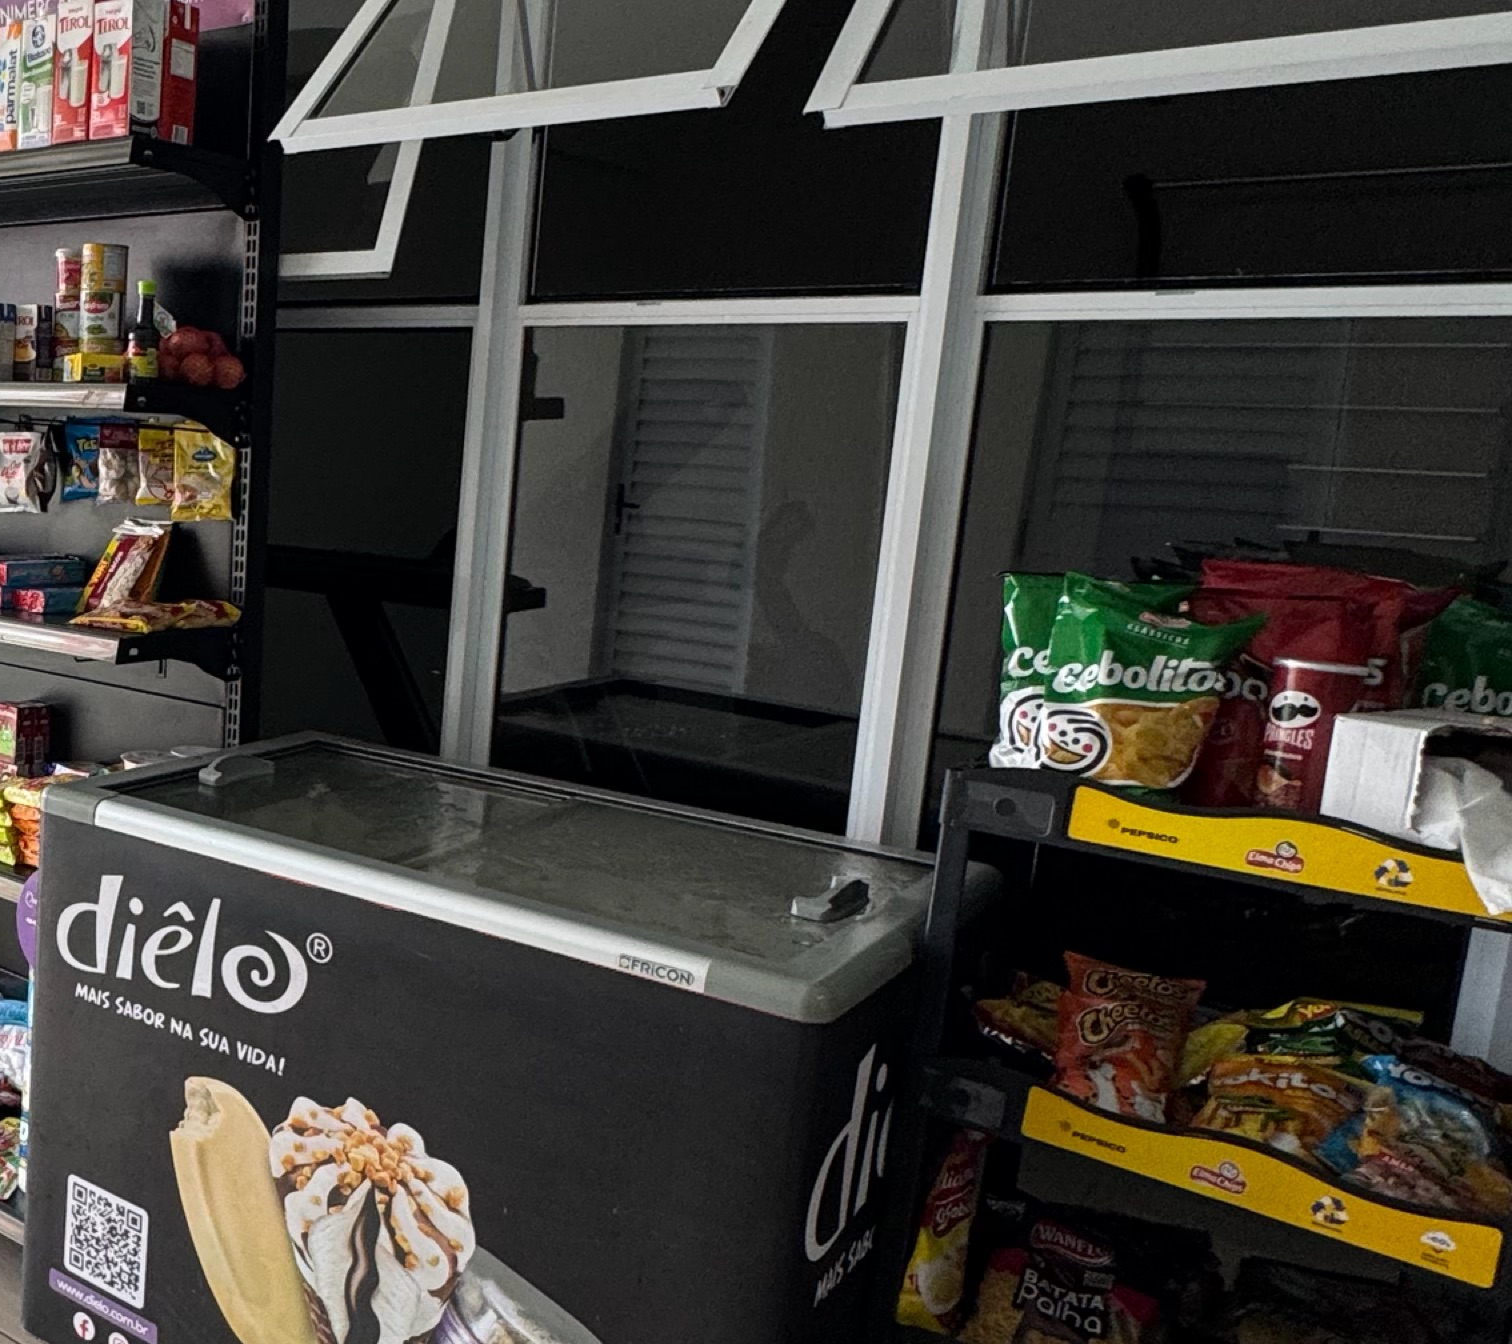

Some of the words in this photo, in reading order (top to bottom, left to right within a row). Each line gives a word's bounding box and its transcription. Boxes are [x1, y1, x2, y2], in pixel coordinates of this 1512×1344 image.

[59, 14, 91, 34] TIROL
[97, 16, 131, 36] TIROL
[5, 48, 18, 125] parmalat
[1264, 723, 1315, 751] PRINGLES
[1120, 826, 1180, 844] PEPSICO
[56, 874, 308, 1014] diêlo
[631, 958, 691, 986] FRICON
[75, 982, 110, 1008] MAIS
[115, 996, 165, 1029] SABOR
[170, 1017, 193, 1040] NA
[199, 1028, 229, 1055] SUA
[236, 1041, 286, 1076] VIDA!
[1071, 1130, 1127, 1154] PEPSICO
[1024, 1267, 1105, 1311] BATATA
[1016, 1284, 1102, 1335] Palha
